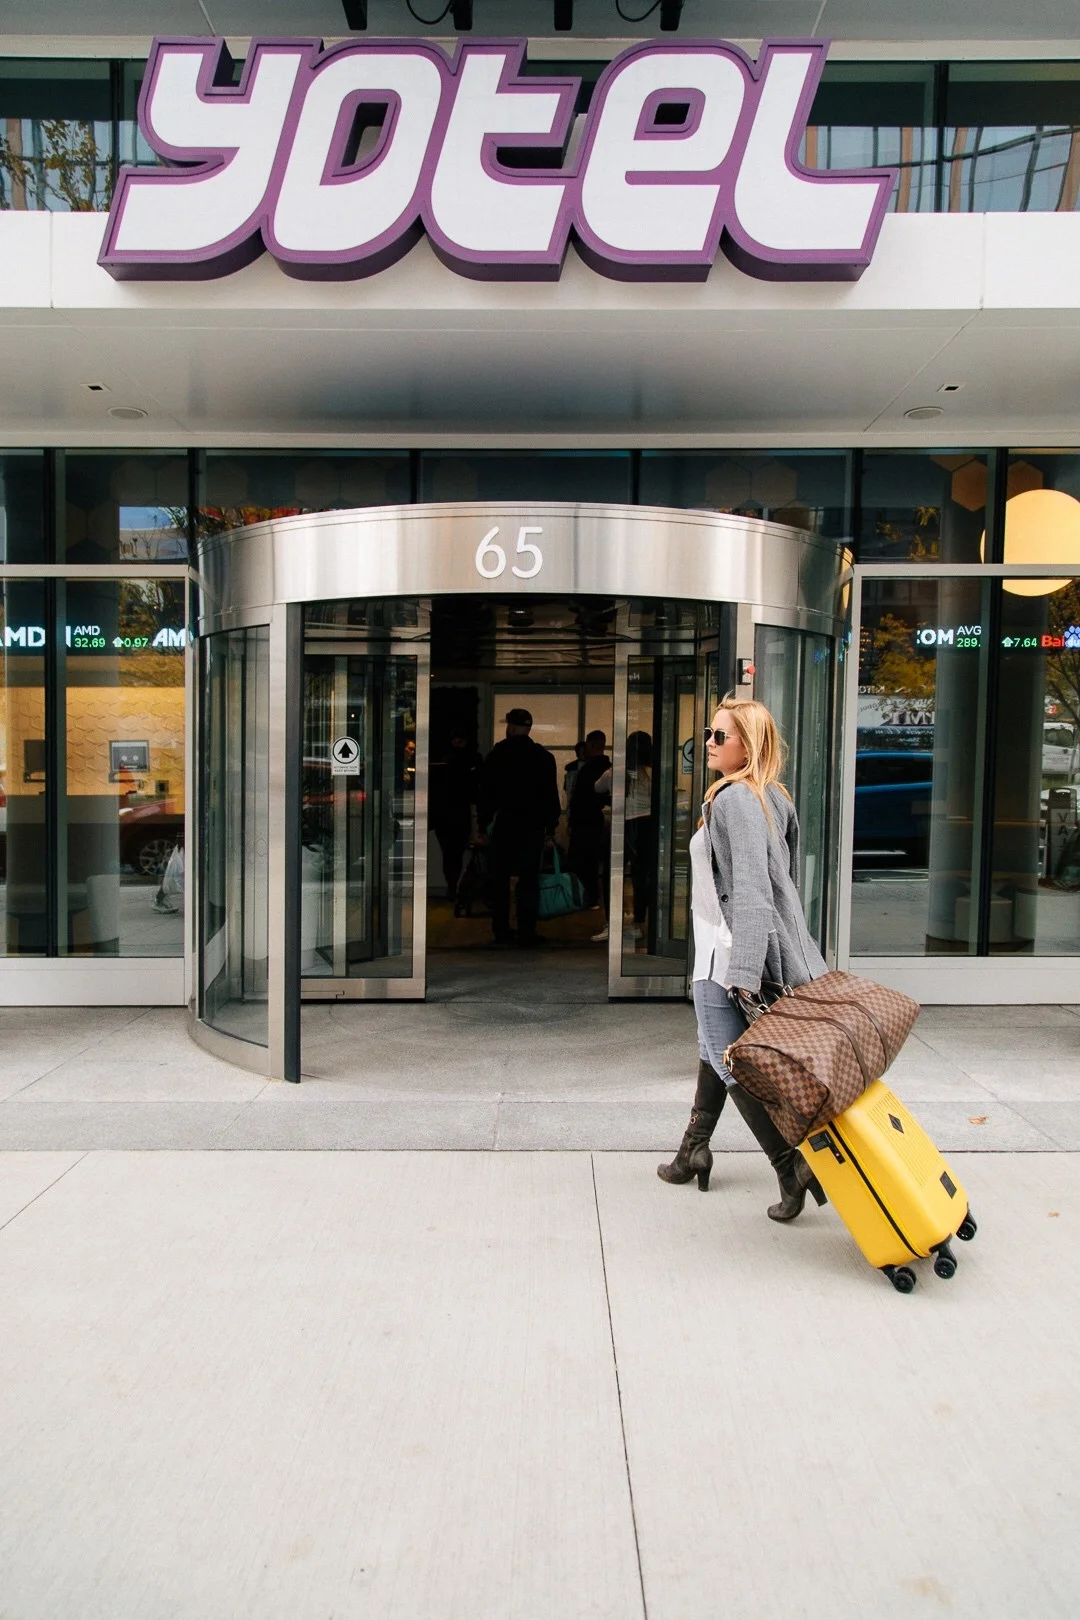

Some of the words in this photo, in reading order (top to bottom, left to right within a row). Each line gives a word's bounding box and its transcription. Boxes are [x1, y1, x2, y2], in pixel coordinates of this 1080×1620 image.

[475, 526, 543, 579] 65
[0, 626, 46, 647] MD
[73, 625, 100, 636] AMD
[917, 629, 954, 645] OM
[956, 625, 982, 636] AVG
[74, 637, 106, 648] 32.69
[152, 628, 186, 647] AM
[1013, 637, 1038, 648] 7.64
